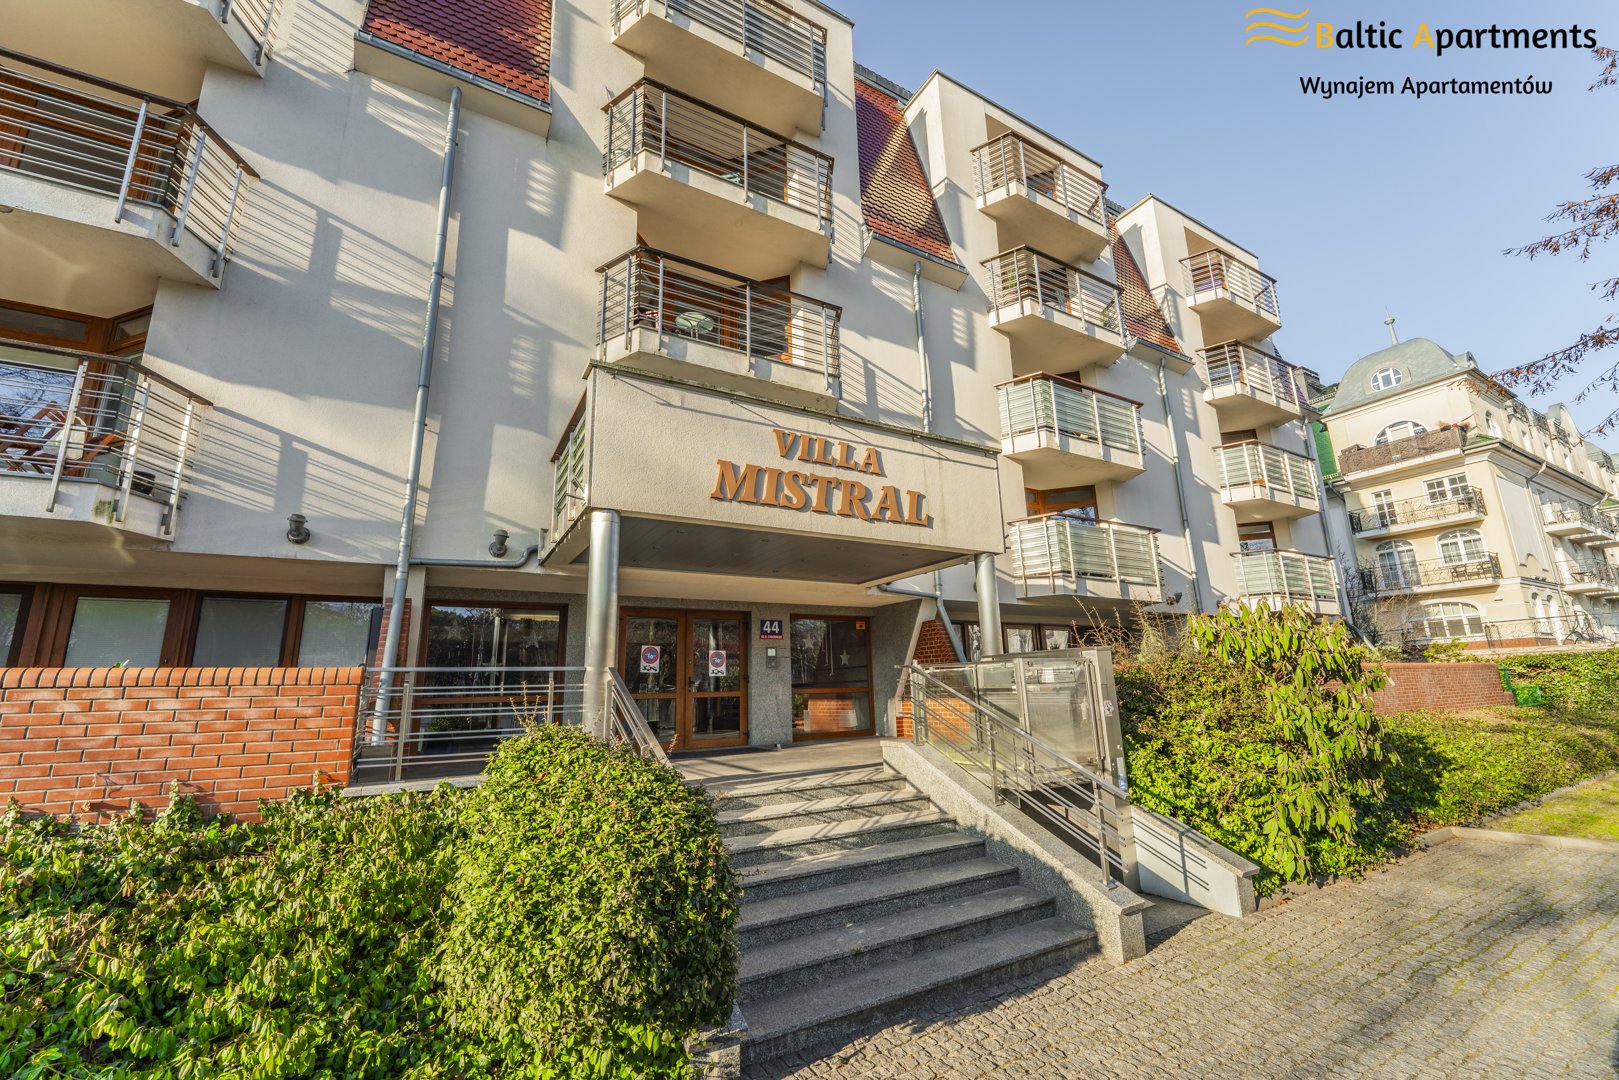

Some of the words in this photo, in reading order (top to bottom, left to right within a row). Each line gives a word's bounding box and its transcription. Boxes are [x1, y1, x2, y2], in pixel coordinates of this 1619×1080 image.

[772, 428, 883, 476] VILLA
[710, 458, 930, 527] MISTRAL
[763, 621, 779, 634] 44
